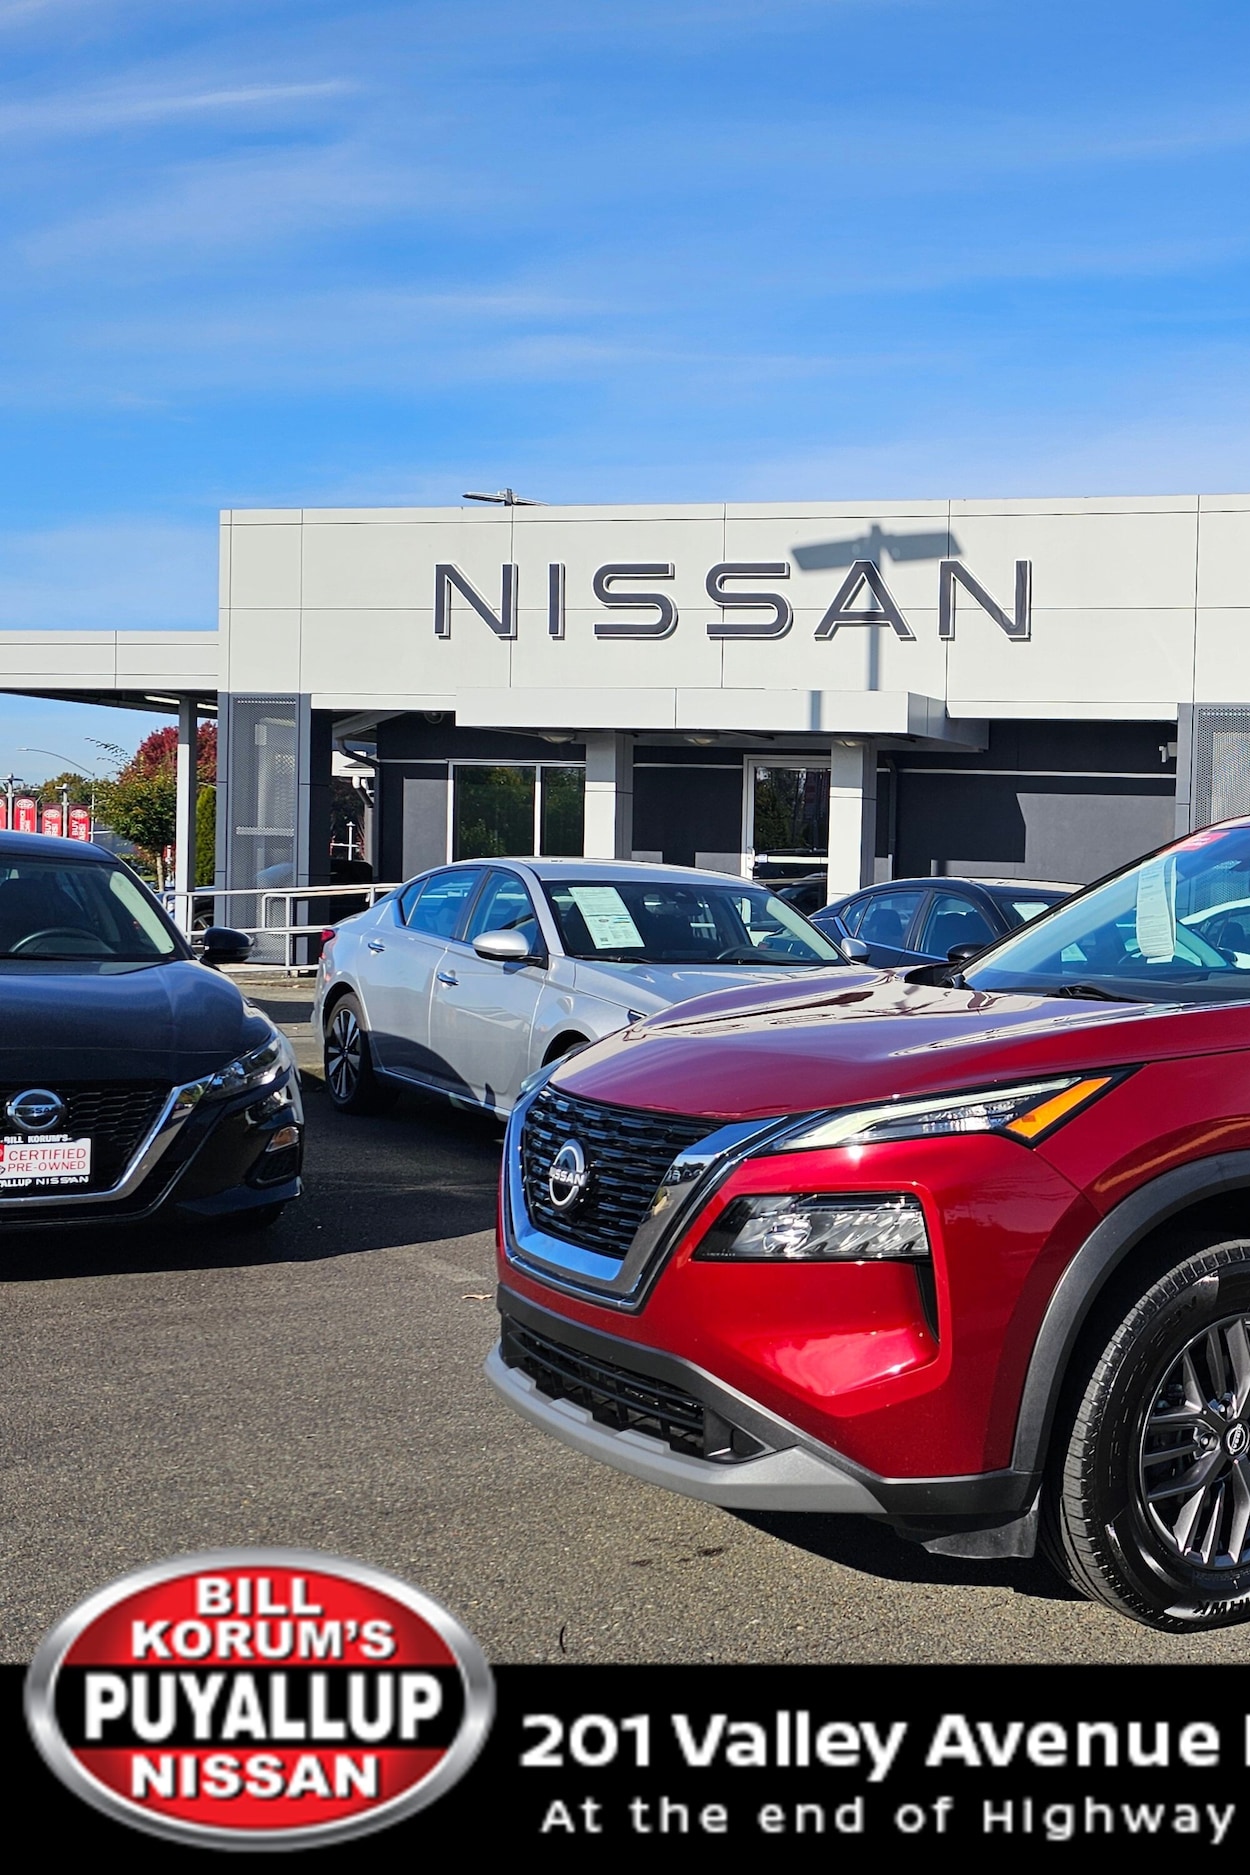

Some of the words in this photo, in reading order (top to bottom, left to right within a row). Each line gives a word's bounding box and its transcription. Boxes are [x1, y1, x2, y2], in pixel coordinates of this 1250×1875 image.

[435, 559, 1032, 642] NISSAN
[8, 1148, 87, 1161] CERTIFIED
[7, 1160, 86, 1173] PRE-OWNED
[35, 1175, 90, 1186] NISSAN
